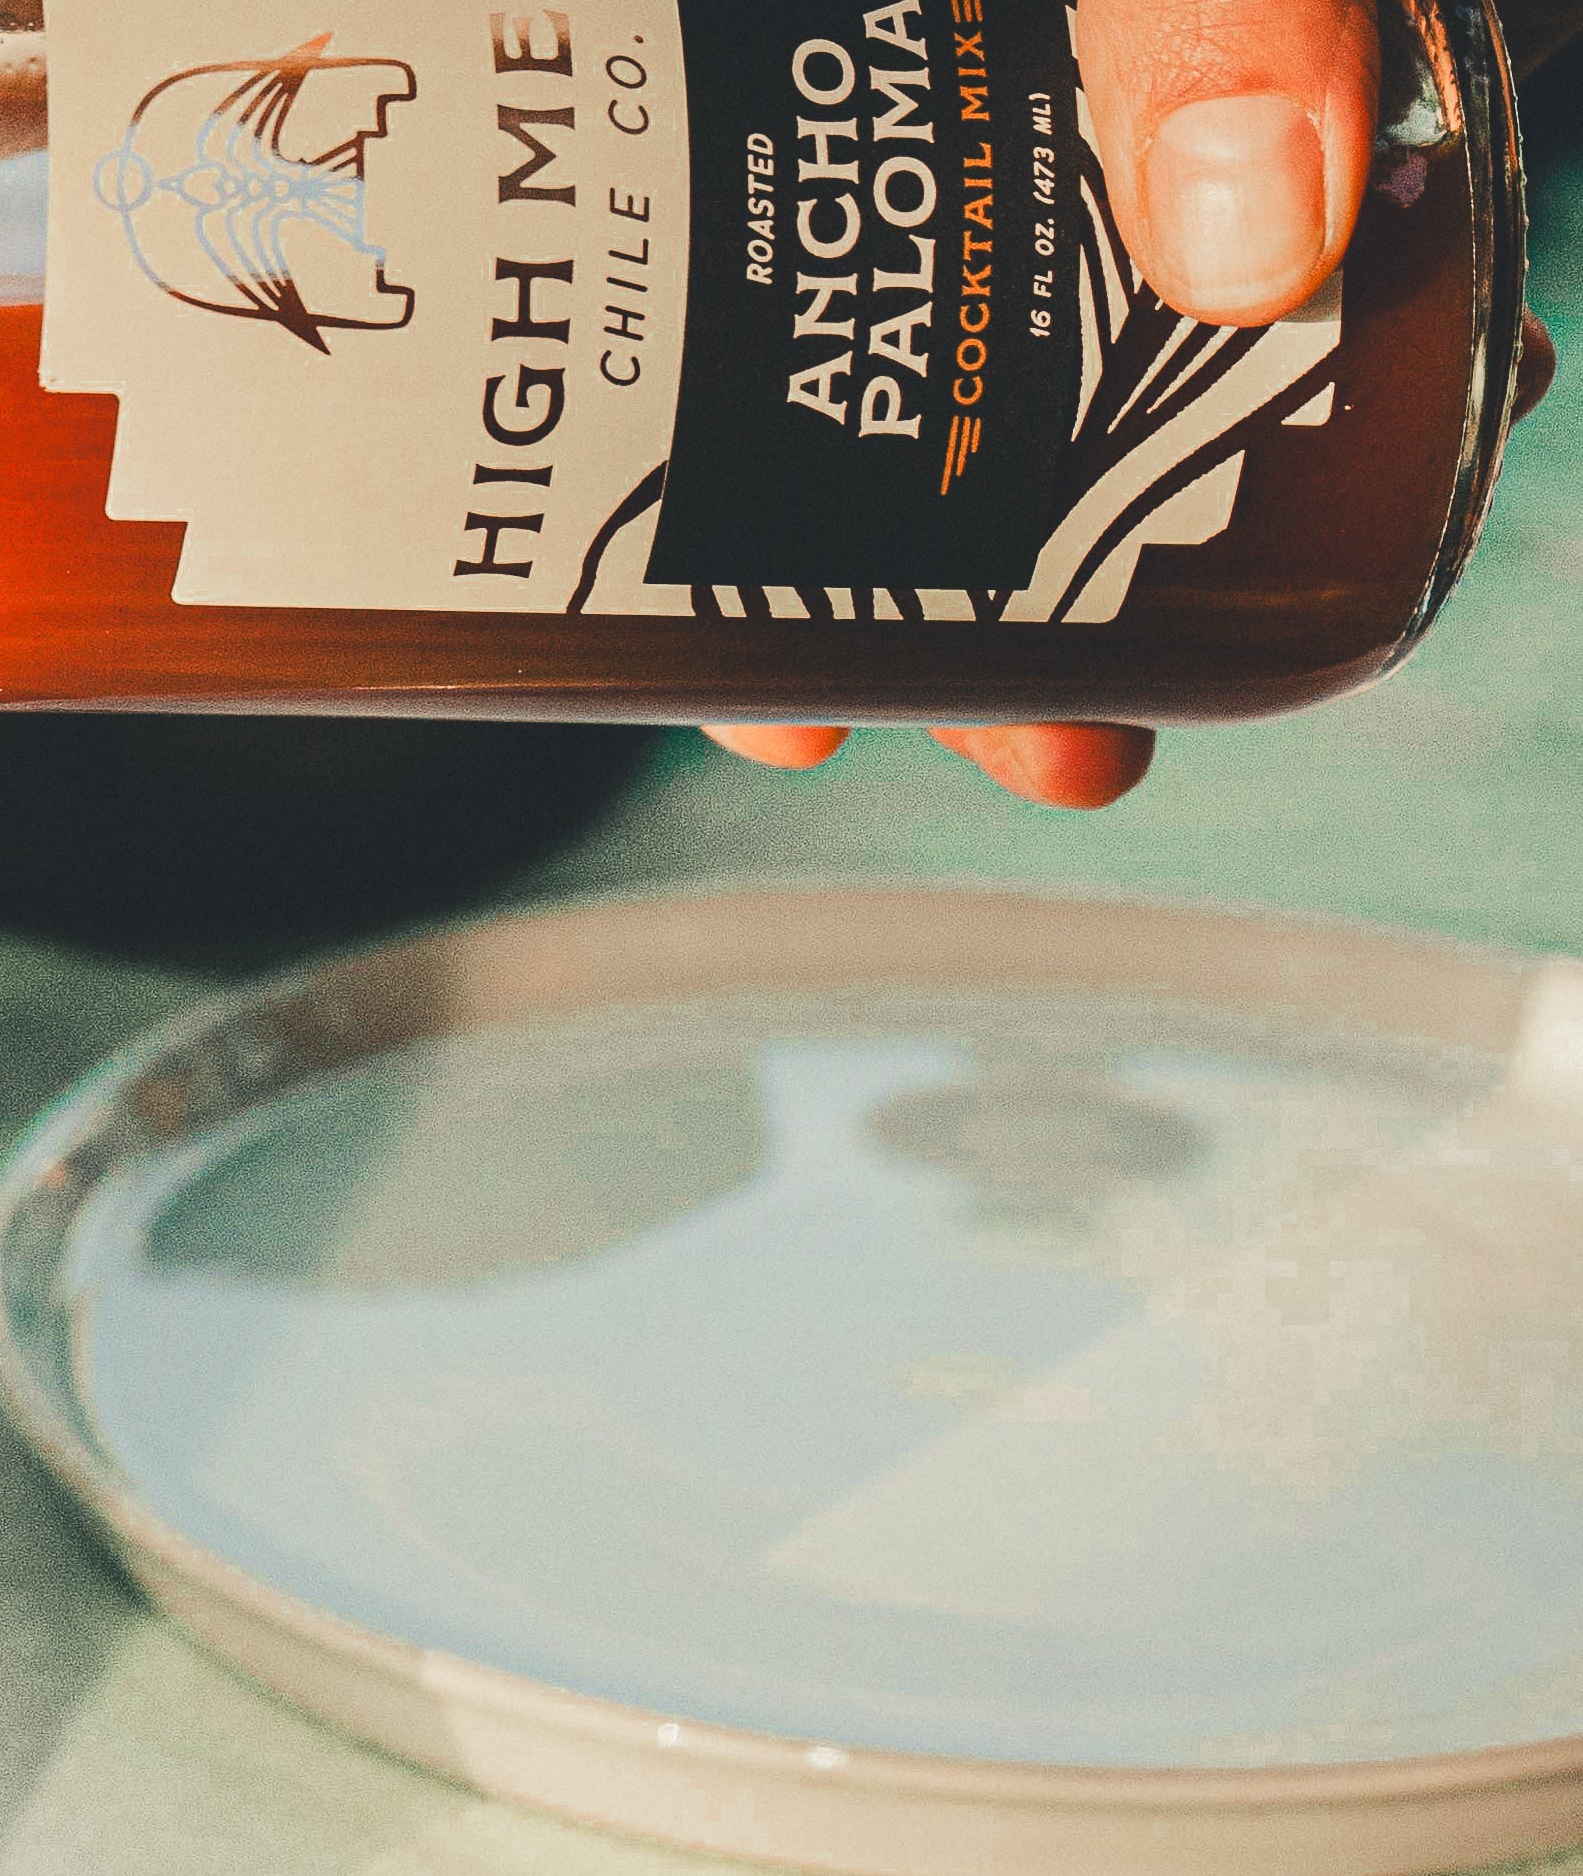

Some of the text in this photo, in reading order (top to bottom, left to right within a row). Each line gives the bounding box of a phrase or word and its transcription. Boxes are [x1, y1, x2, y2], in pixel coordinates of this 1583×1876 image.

[599, 33, 650, 386] CHILE CO.
[746, 131, 775, 286] ROASTED
[786, 37, 862, 426] ANCHO
[952, 30, 993, 406] COCKTAIL MIX
[1028, 92, 1057, 338] 16 FL OZ. (473 ML)
[453, 255, 576, 579] HIGH
